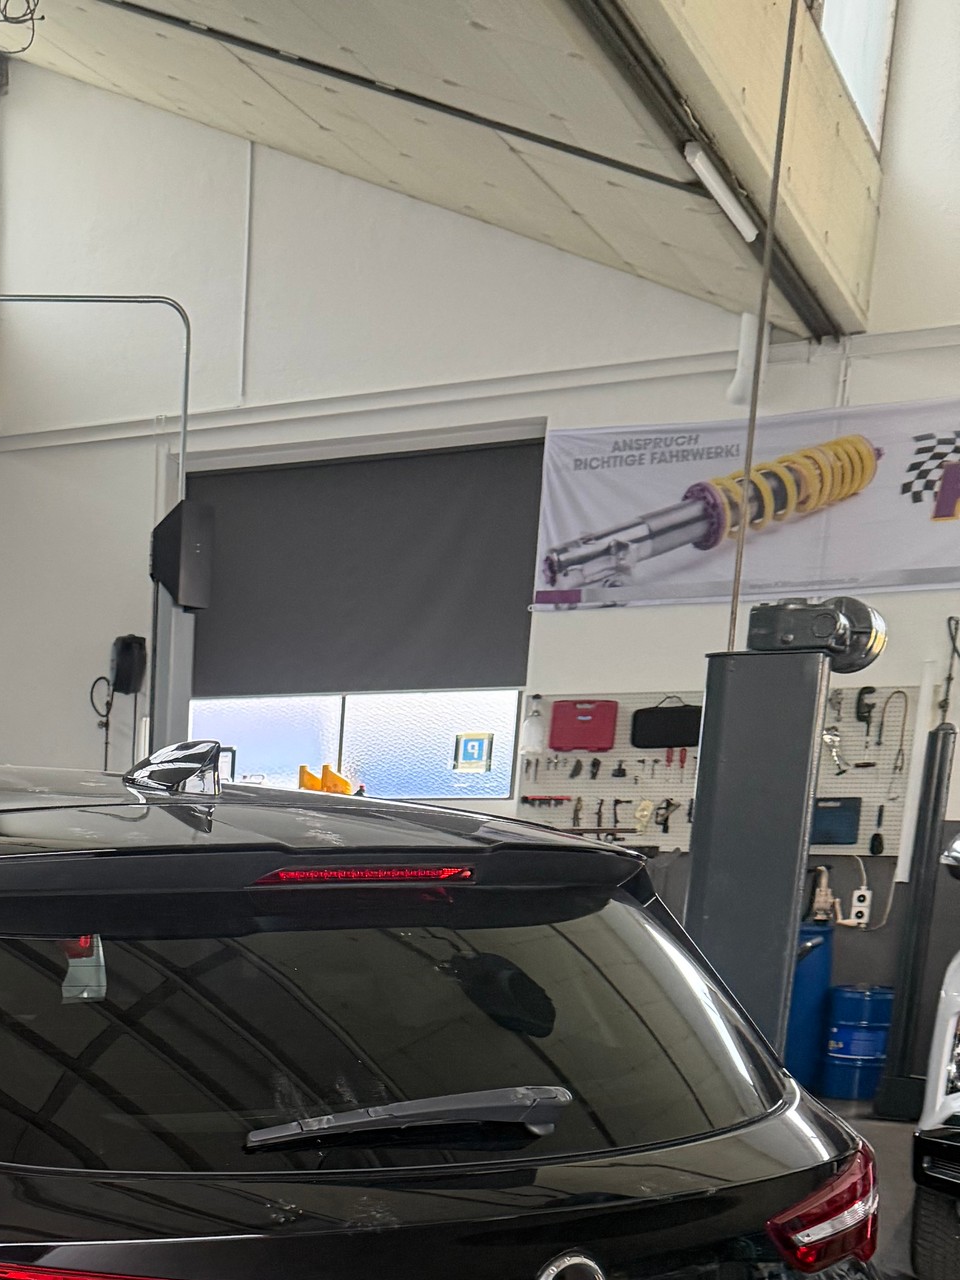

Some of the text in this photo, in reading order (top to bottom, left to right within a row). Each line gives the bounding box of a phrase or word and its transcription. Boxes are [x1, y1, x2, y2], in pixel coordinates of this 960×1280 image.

[611, 434, 700, 453] ANSPRUCH
[573, 443, 740, 471] RICHTIGE FAHRWERK!
